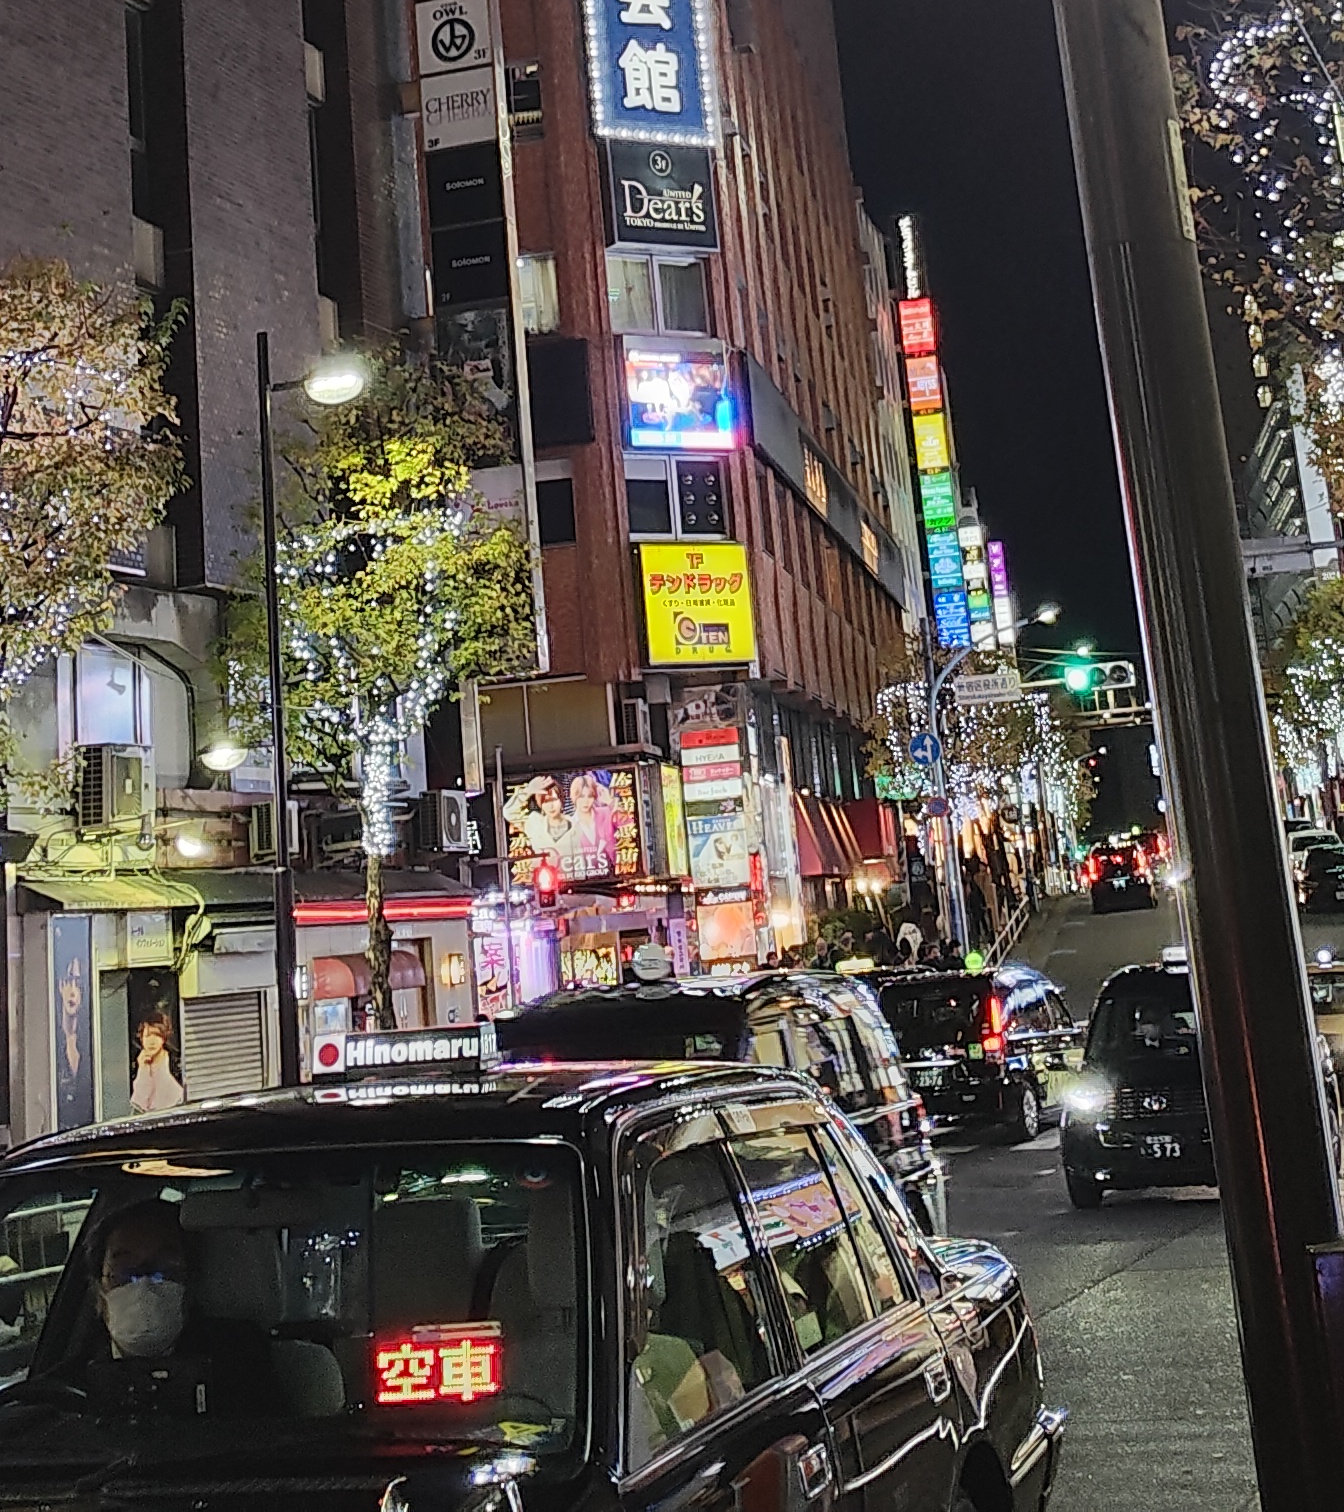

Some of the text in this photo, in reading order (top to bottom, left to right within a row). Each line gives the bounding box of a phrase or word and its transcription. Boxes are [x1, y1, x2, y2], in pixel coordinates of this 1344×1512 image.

[432, 5, 468, 22] OWL
[473, 48, 489, 61] 3F
[425, 89, 492, 115] CHERRY
[427, 138, 441, 149] 3F
[620, 179, 705, 223] Dear's
[625, 216, 654, 228] TOKYO
[648, 571, 744, 596] テンドラッグ
[701, 631, 730, 645] TEN
[346, 1035, 479, 1067] Hinomaru
[376, 1340, 497, 1403] 空車
